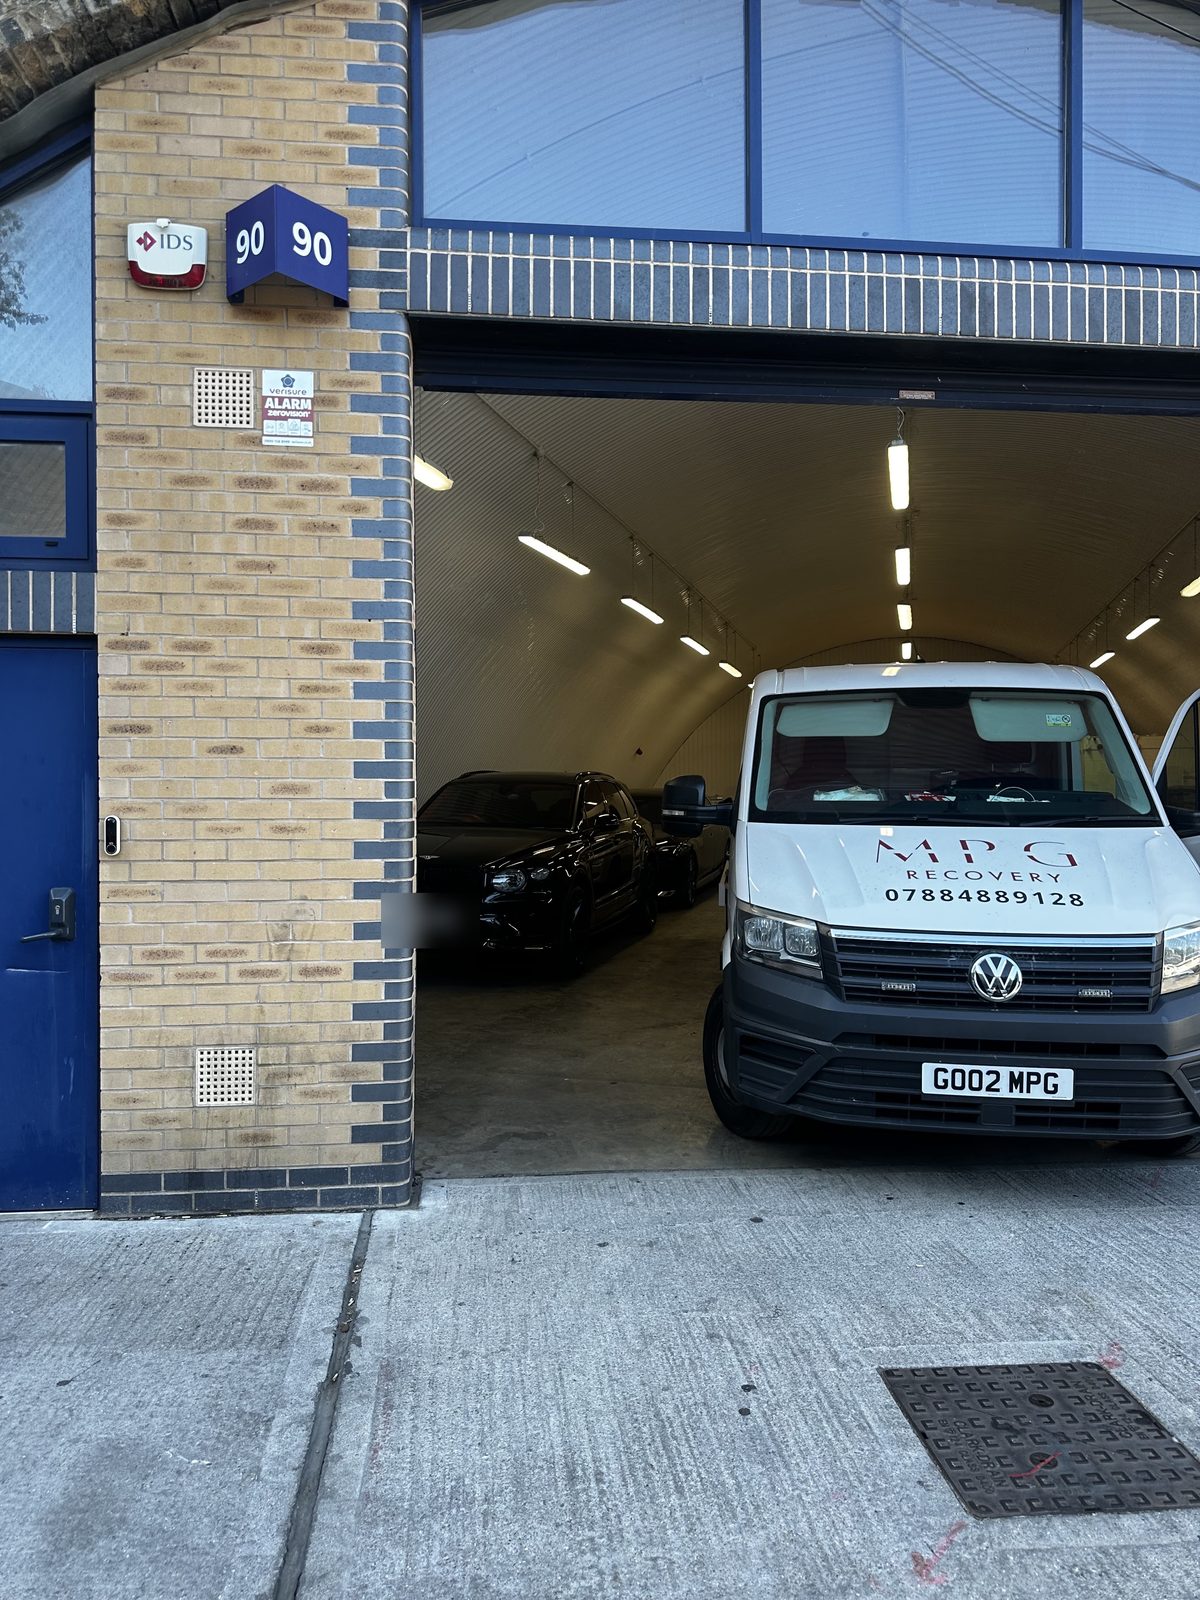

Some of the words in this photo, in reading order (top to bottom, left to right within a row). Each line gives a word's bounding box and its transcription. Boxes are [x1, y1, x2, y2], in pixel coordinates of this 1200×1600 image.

[160, 233, 193, 251] IDS
[236, 220, 265, 265] 90
[292, 221, 333, 266] 90
[269, 388, 307, 396] verisure
[264, 397, 312, 410] ALARM
[906, 869, 1062, 883] RECOVERY
[885, 888, 1085, 907] 07884889128
[1008, 1071, 1059, 1095] MPG
